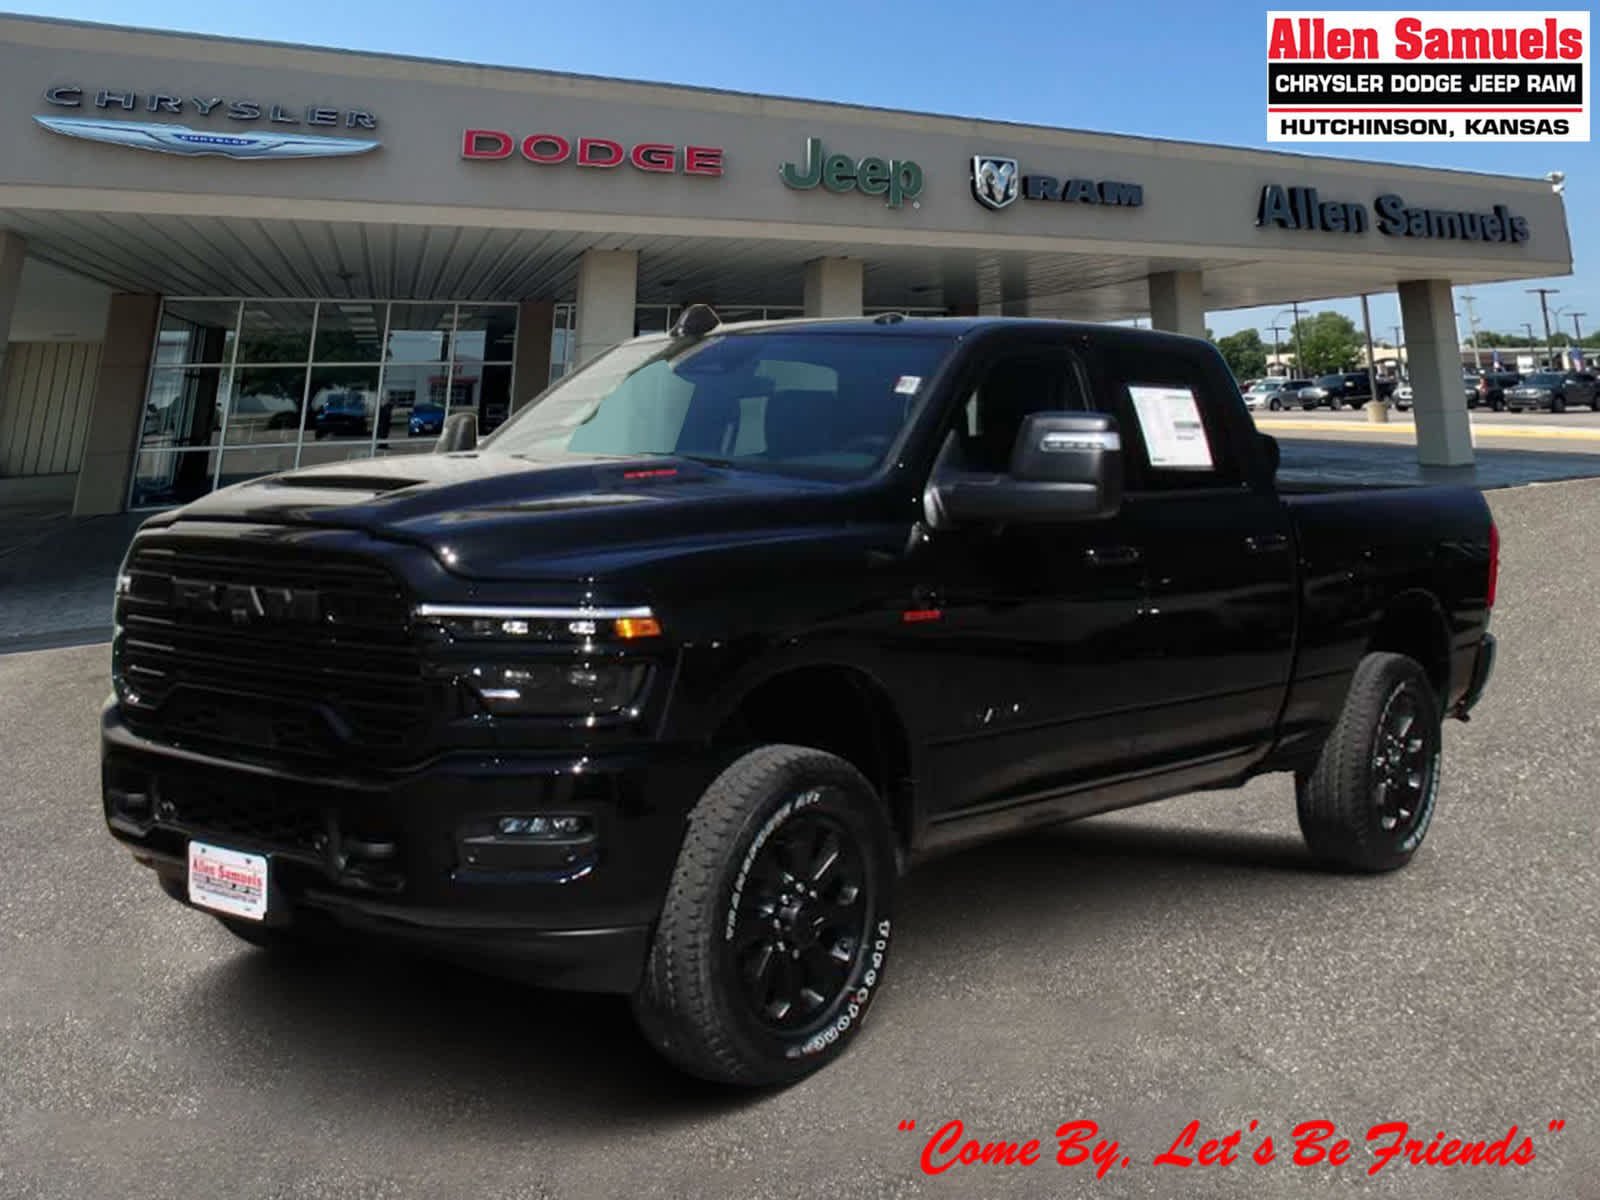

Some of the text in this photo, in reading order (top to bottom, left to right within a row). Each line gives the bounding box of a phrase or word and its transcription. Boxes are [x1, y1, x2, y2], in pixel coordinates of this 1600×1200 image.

[44, 86, 378, 129] CHRYSLER
[462, 128, 725, 177] DODGE
[780, 136, 923, 208] Jeep
[1022, 175, 1144, 208] RAM
[1255, 184, 1530, 244] Allen Samuels
